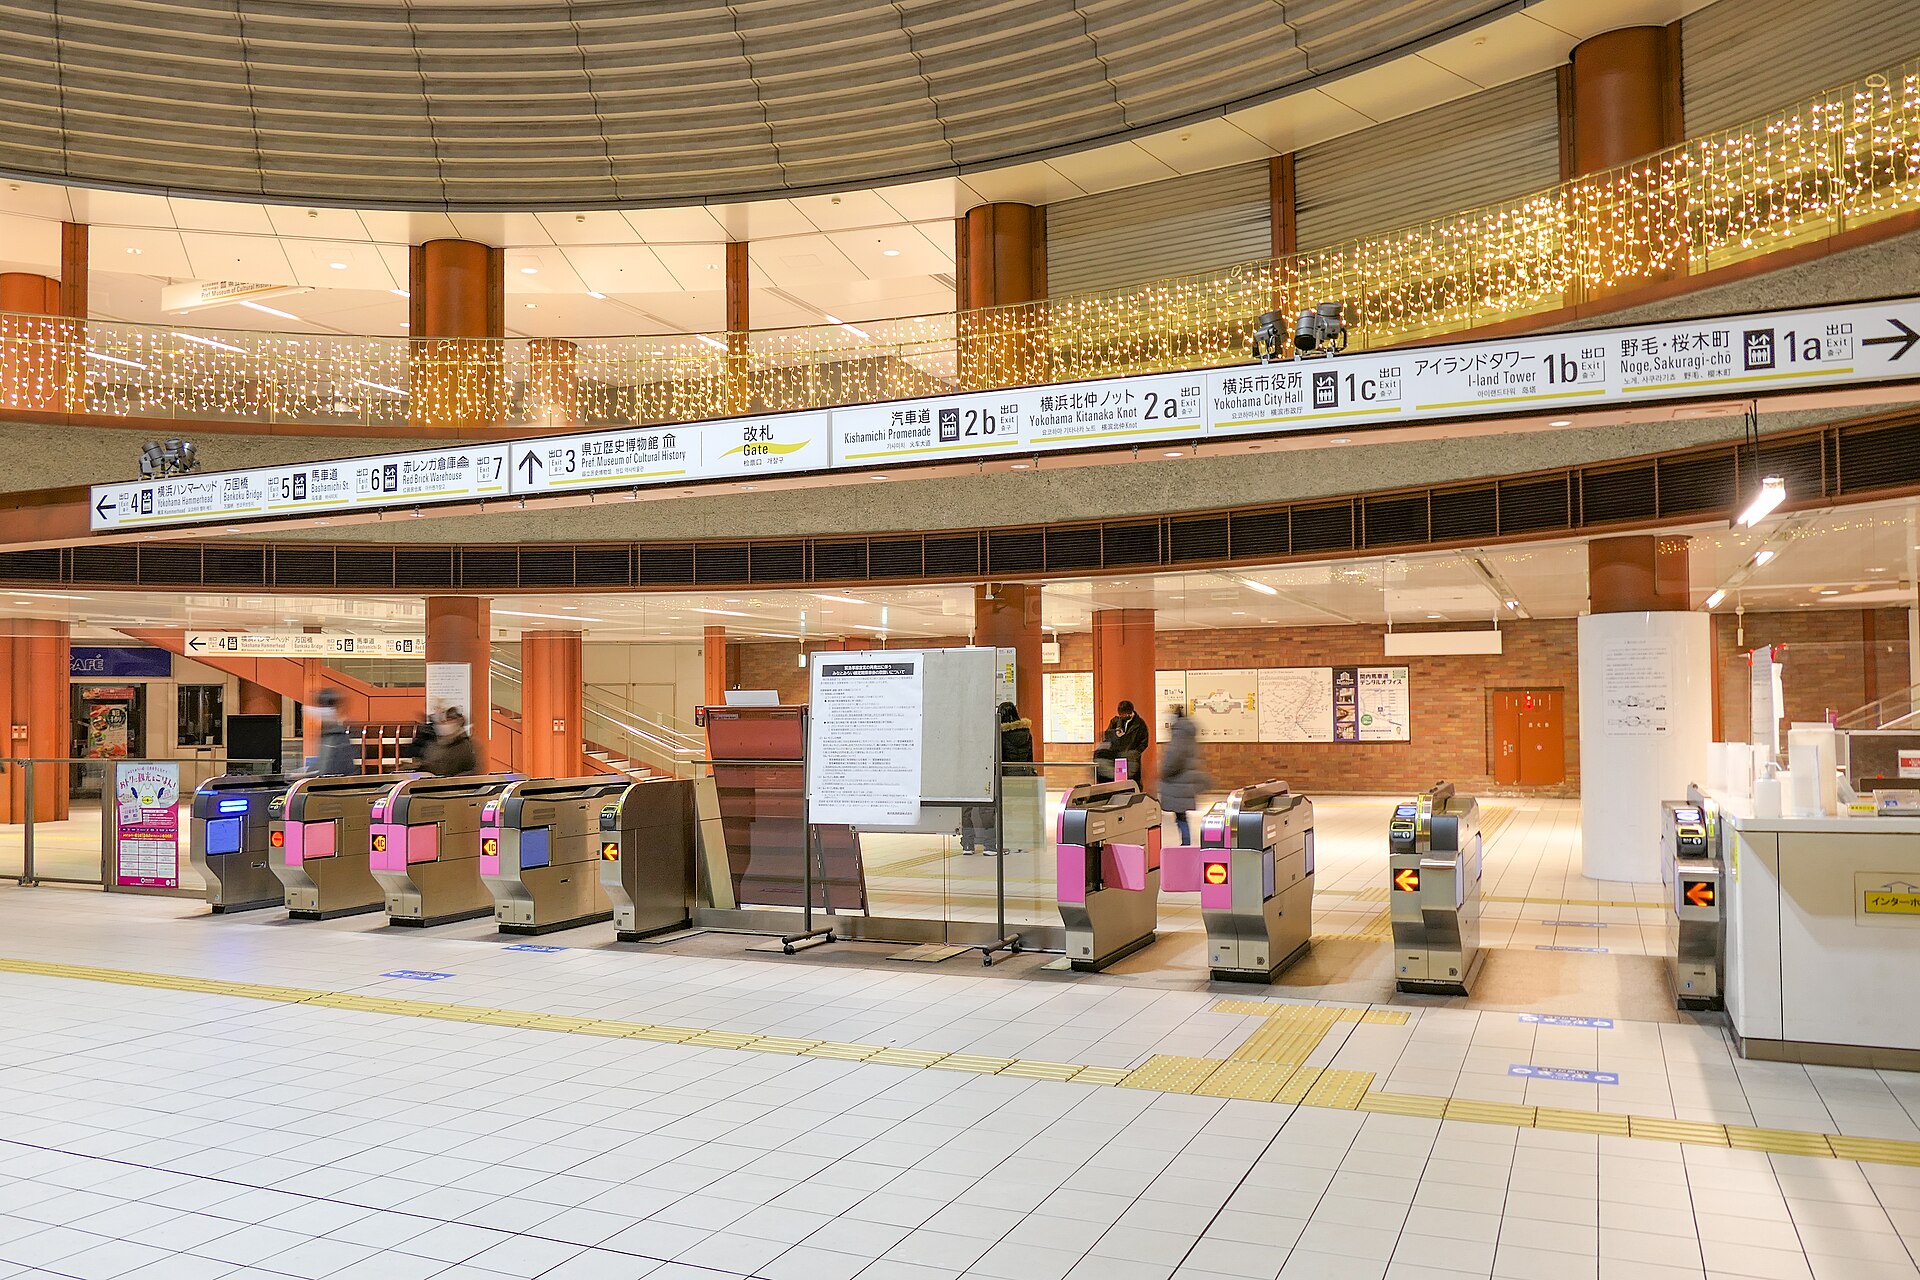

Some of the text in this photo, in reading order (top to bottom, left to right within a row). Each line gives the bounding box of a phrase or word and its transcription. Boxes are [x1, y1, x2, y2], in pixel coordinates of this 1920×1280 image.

[1826, 323, 1852, 336] 出口
[1620, 330, 1730, 358] 野毛・桜木町
[1784, 330, 1821, 362] 1a
[1826, 338, 1848, 347] Exit
[1581, 348, 1605, 358] 出口
[1414, 351, 1536, 376] アイランドタワー
[1543, 353, 1578, 384] 1b
[1582, 362, 1600, 370] Exit
[1380, 367, 1400, 378] 出口
[1468, 370, 1536, 387] I-land Tower
[1222, 371, 1303, 396] 横浜市役所
[1345, 373, 1376, 402] 1c
[1380, 381, 1396, 389] Exit
[1180, 386, 1200, 398] 出口
[1040, 388, 1135, 412] 横浜北仲ノット
[1144, 392, 1178, 420] 2a
[1181, 399, 1196, 408] Exit
[1214, 390, 1304, 410] Yokohama City Hall
[1000, 404, 1018, 414] 出口
[1030, 406, 1138, 427] Yokohama Kitanaka Knot
[891, 408, 930, 426] 汽車道
[964, 408, 996, 436] 2b
[1000, 416, 1014, 424] Exit
[743, 424, 774, 442] 改札
[844, 426, 932, 444] Kishamichi Promenade
[581, 436, 659, 456] 県立歴史博物館
[743, 444, 768, 456] Gate
[476, 456, 490, 466] 出口
[548, 450, 562, 458] 出口
[565, 450, 576, 473] 3
[596, 456, 624, 466] Museum
[626, 454, 632, 464] of
[633, 450, 660, 464] Cultural
[661, 450, 686, 462] History
[356, 468, 368, 476] 出口
[403, 456, 456, 474] 赤レンガ倉庫
[493, 456, 502, 480] 7
[268, 476, 279, 485] 出口
[312, 468, 338, 482] 馬車道
[371, 468, 380, 490] 6
[402, 472, 462, 484] Red Brick Warehouse
[158, 481, 218, 498] 横浜ハンマーヘッド
[224, 476, 249, 491] 万国橋
[282, 478, 290, 498] 5
[311, 482, 342, 493] Bashamichi
[130, 493, 138, 512] 4
[158, 494, 213, 508] Yokohama Hammerhead
[224, 492, 244, 502] Bankoku
[246, 490, 263, 500] Bridge
[218, 638, 225, 649] 4
[336, 640, 343, 650] 5
[396, 640, 402, 652] 6
[70, 653, 104, 670] AFÉ
[488, 843, 496, 851] IC
